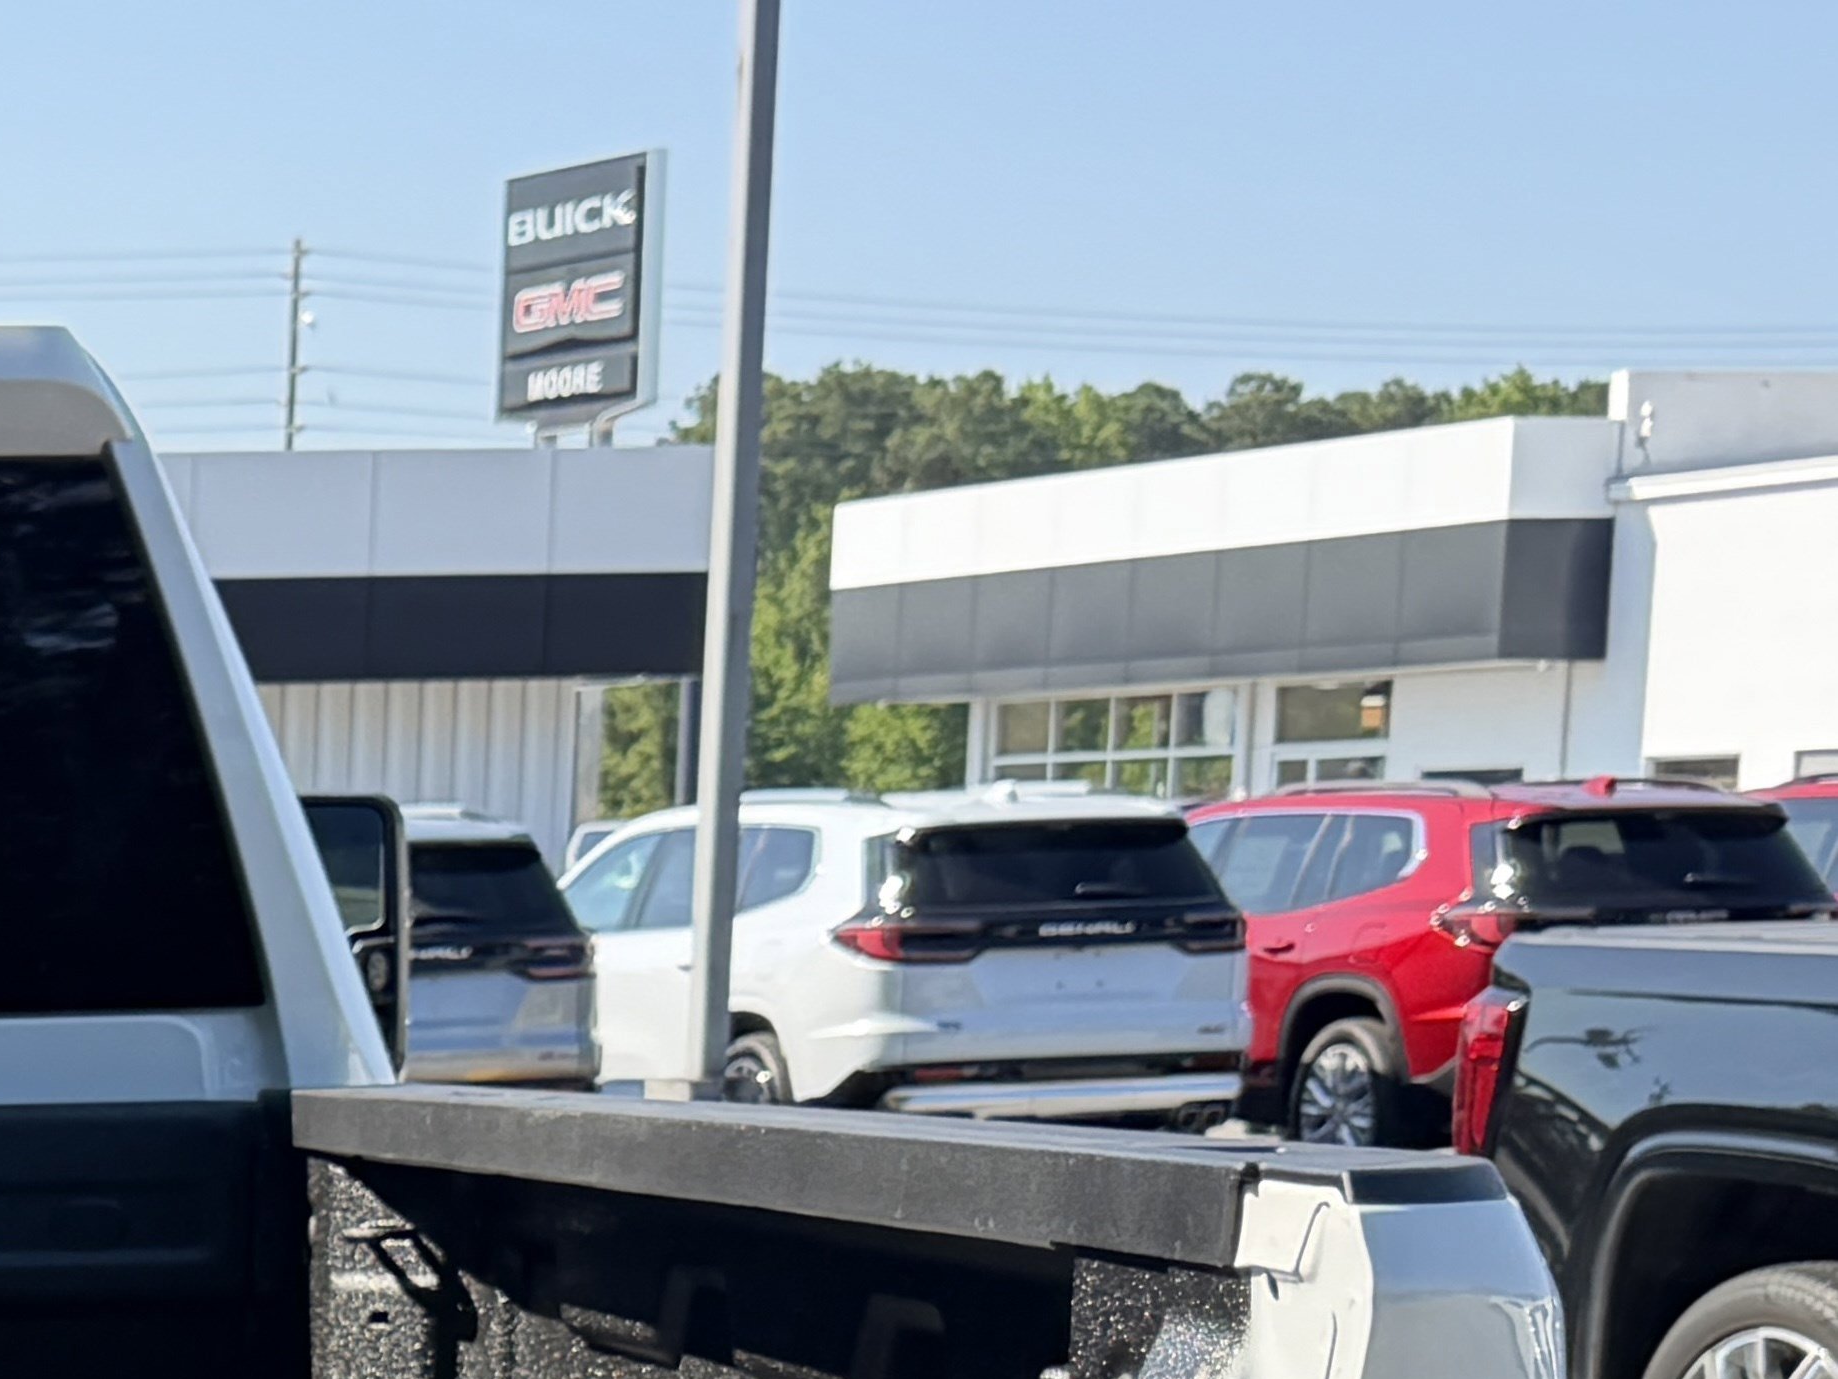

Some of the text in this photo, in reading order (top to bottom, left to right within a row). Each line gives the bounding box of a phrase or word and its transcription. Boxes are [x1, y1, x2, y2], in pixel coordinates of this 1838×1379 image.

[507, 188, 636, 246] BUICK
[513, 269, 625, 334] GMC
[527, 360, 604, 402] MOORE
